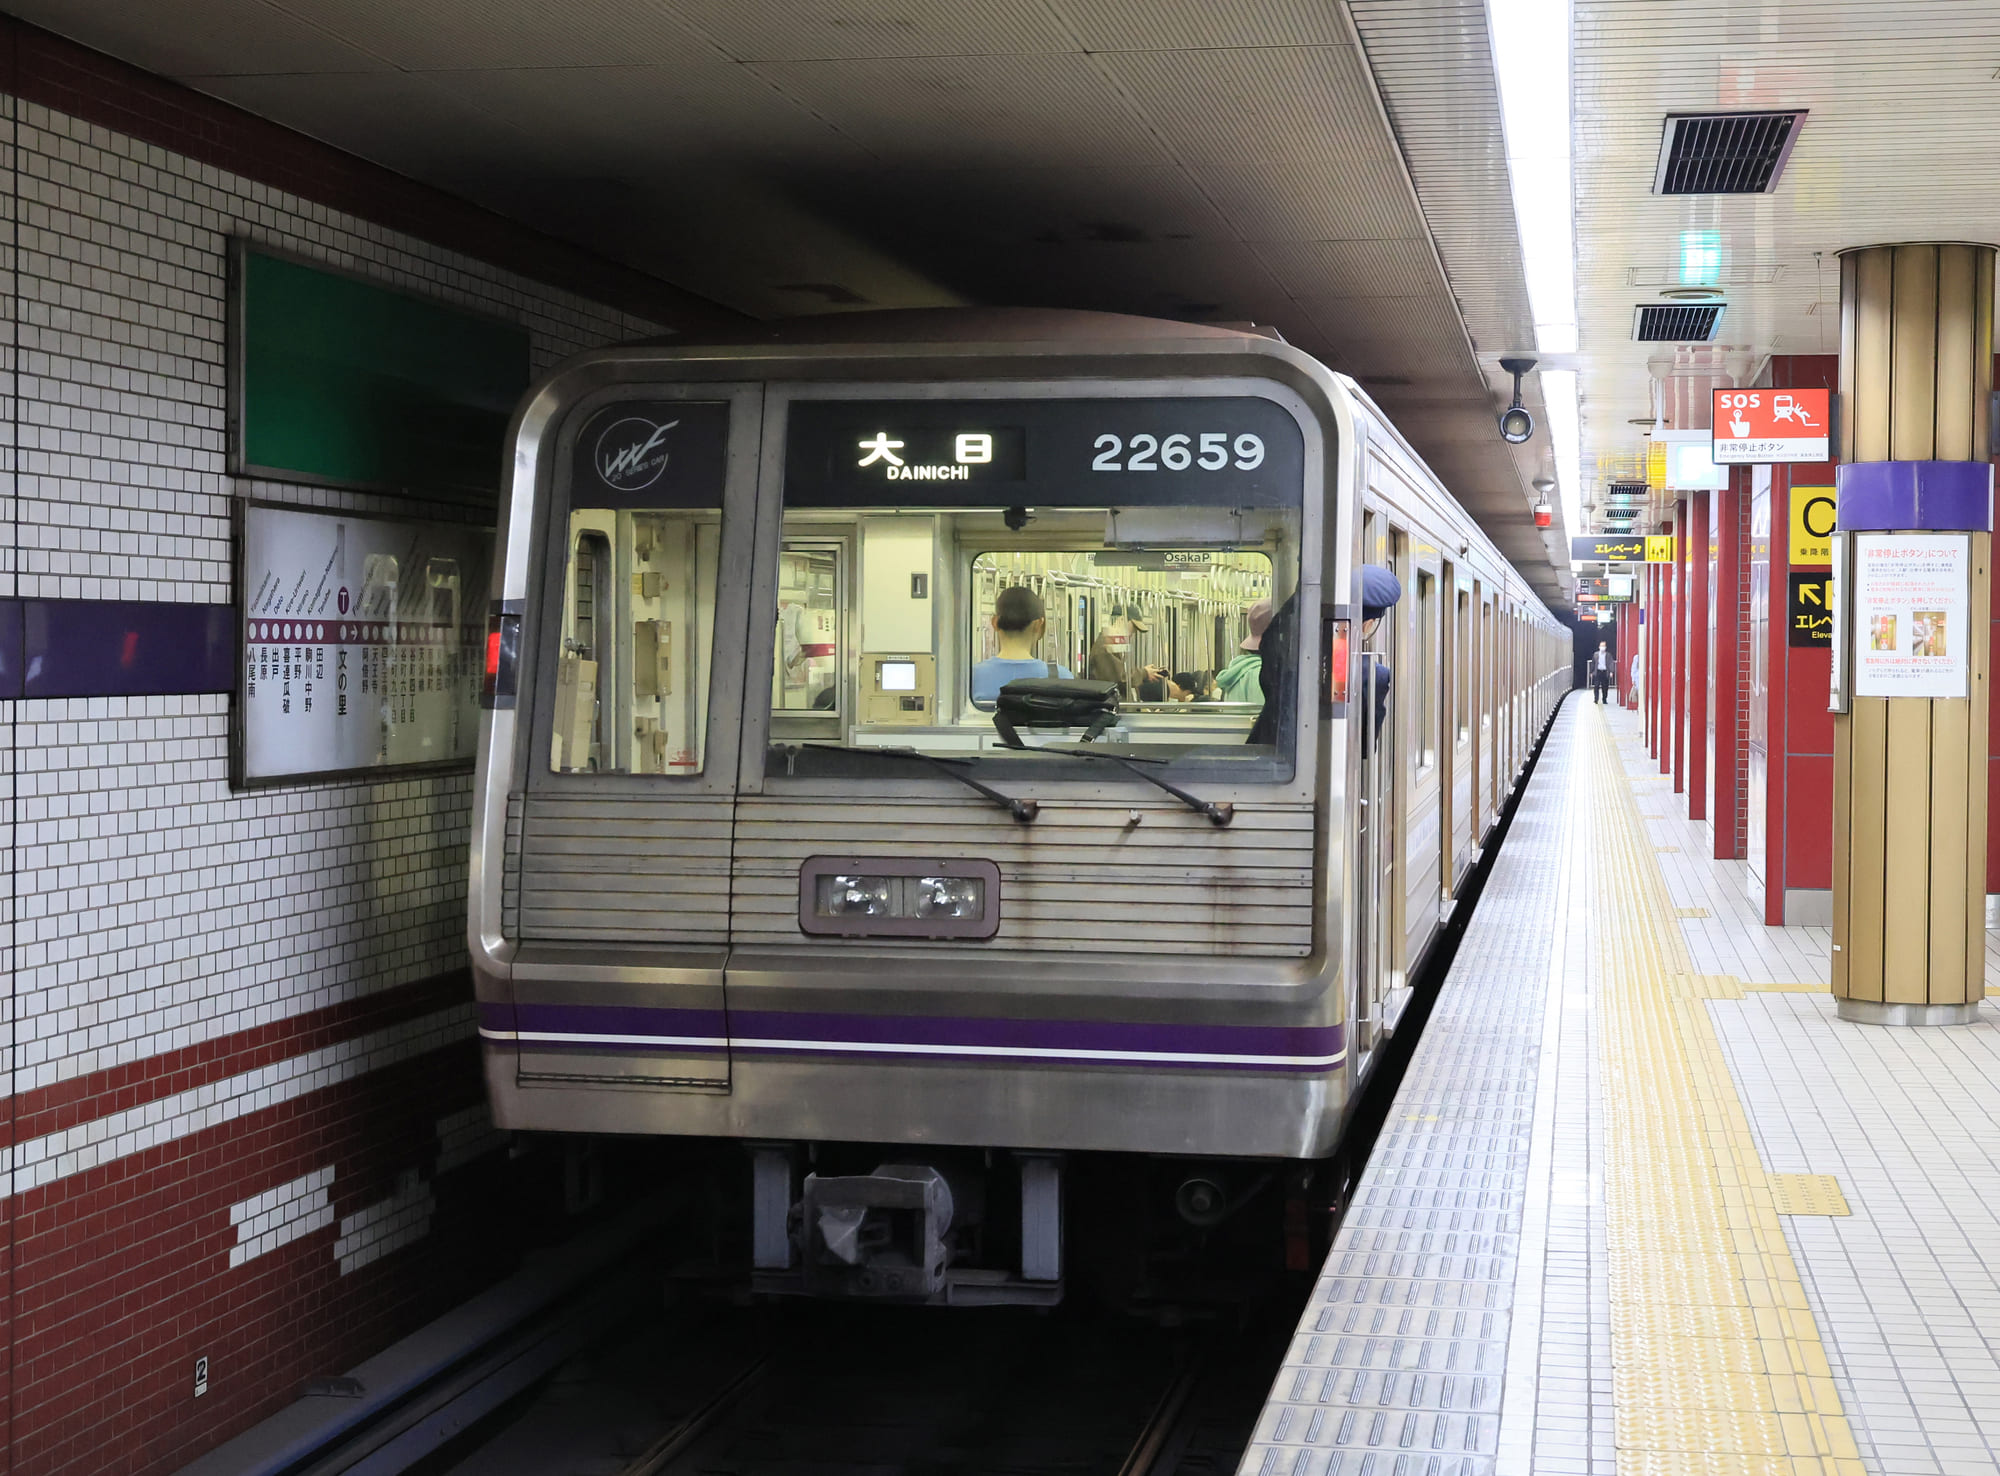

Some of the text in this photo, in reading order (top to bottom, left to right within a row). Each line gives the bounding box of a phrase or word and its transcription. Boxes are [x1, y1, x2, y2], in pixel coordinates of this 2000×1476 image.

[1720, 393, 1761, 409] SOS
[1091, 432, 1266, 471] 22659
[1719, 442, 1785, 453] 非常停止ボタン
[886, 465, 969, 480] DAINICHI
[1803, 496, 1836, 538] C
[1594, 543, 1642, 555] エレベータ
[340, 591, 347, 611] T
[248, 647, 256, 698] 八尾南
[260, 646, 268, 680] 長原
[272, 647, 280, 680] 出戸
[294, 647, 302, 680] 平野
[316, 647, 324, 680] 田辺
[338, 649, 348, 716] 文の里
[197, 1360, 206, 1382] 2
